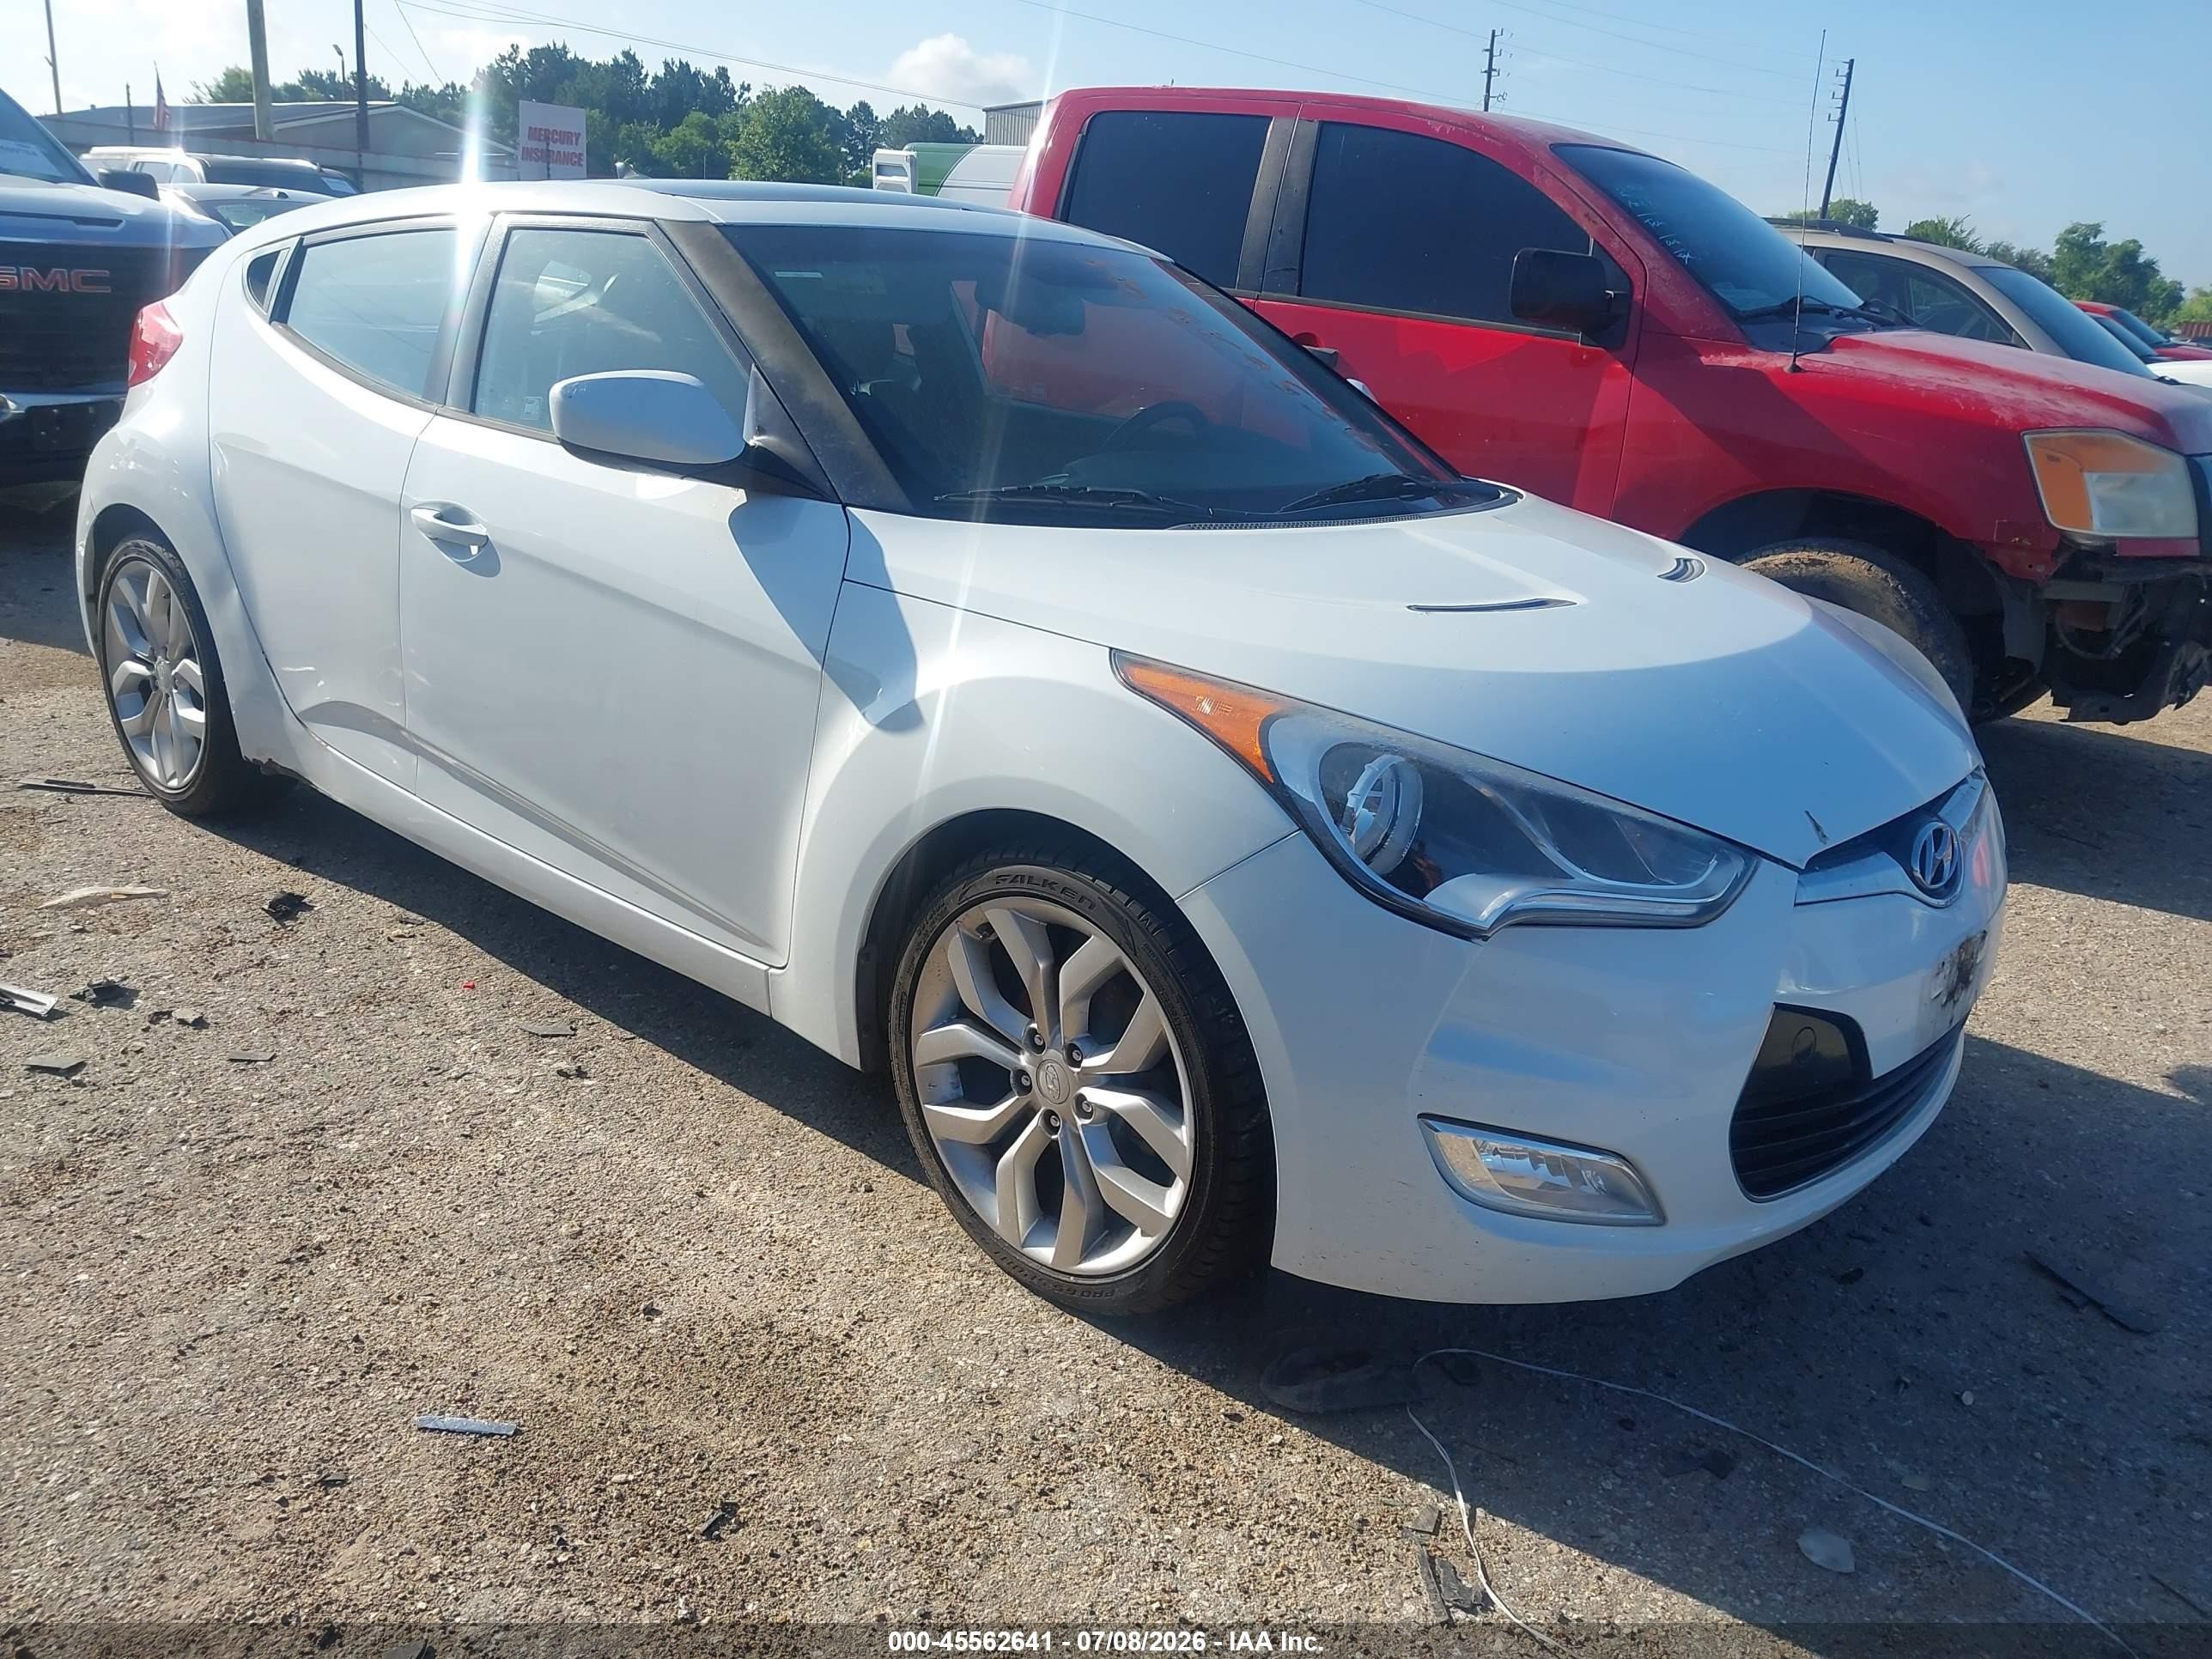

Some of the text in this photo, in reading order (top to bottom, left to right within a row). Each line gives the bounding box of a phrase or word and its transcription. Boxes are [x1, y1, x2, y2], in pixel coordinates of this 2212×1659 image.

[527, 126, 581, 146] MERCURY
[521, 147, 584, 167] INSURANCE
[995, 874, 1097, 911] FALKEN
